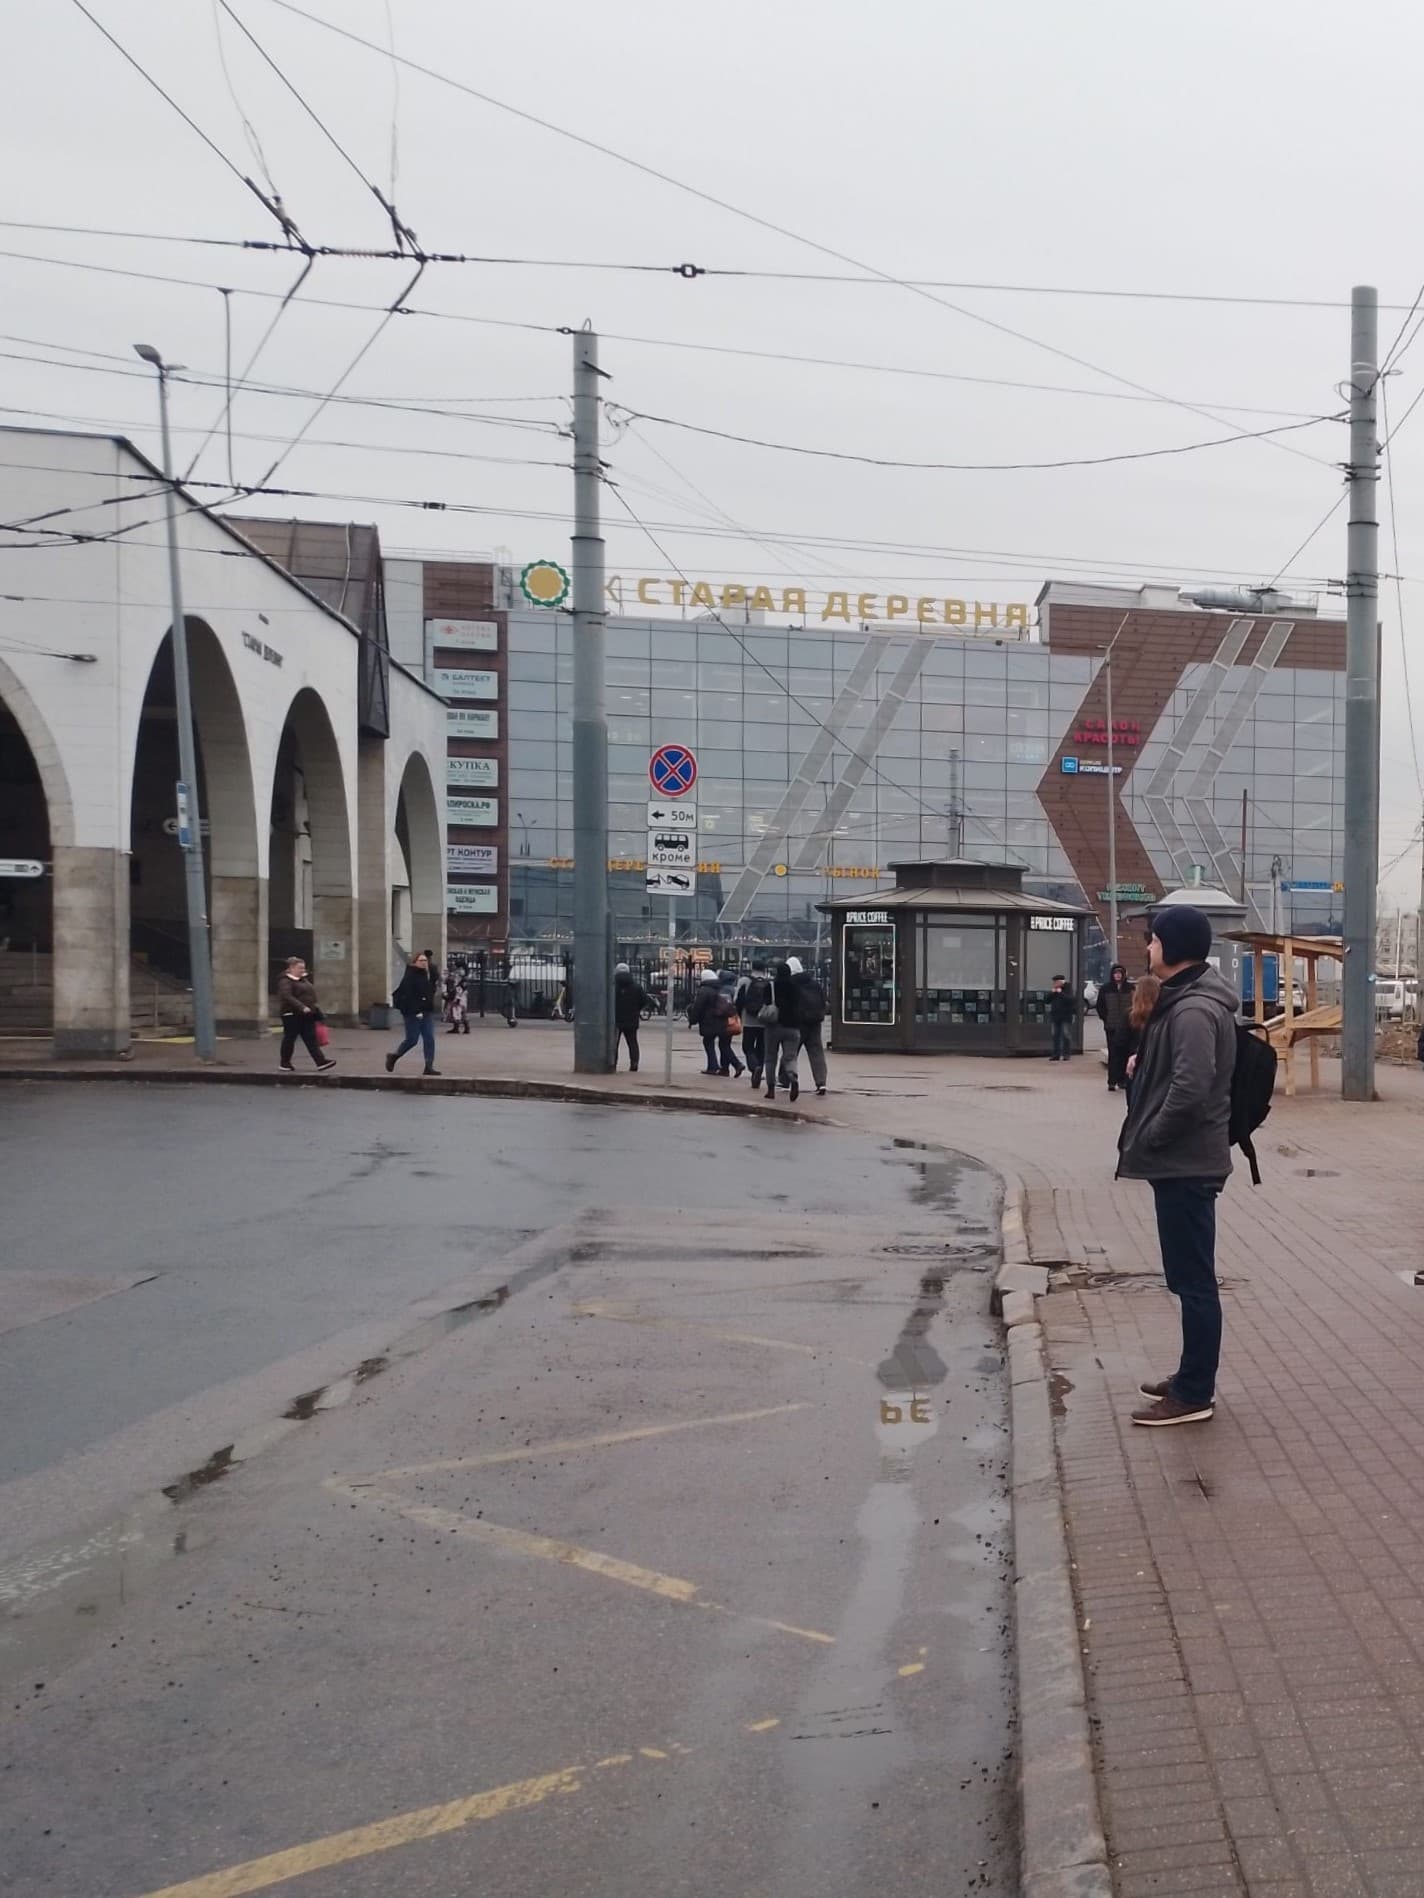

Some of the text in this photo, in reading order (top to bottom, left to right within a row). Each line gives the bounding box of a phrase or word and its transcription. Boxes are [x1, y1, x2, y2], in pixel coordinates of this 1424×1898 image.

[637, 577, 807, 615] СТАРАЯ
[821, 591, 1028, 627] ДЕРЕВНЯ
[671, 809, 695, 823] 50м
[652, 851, 691, 864] кроме
[1053, 917, 1075, 931] COFFEE
